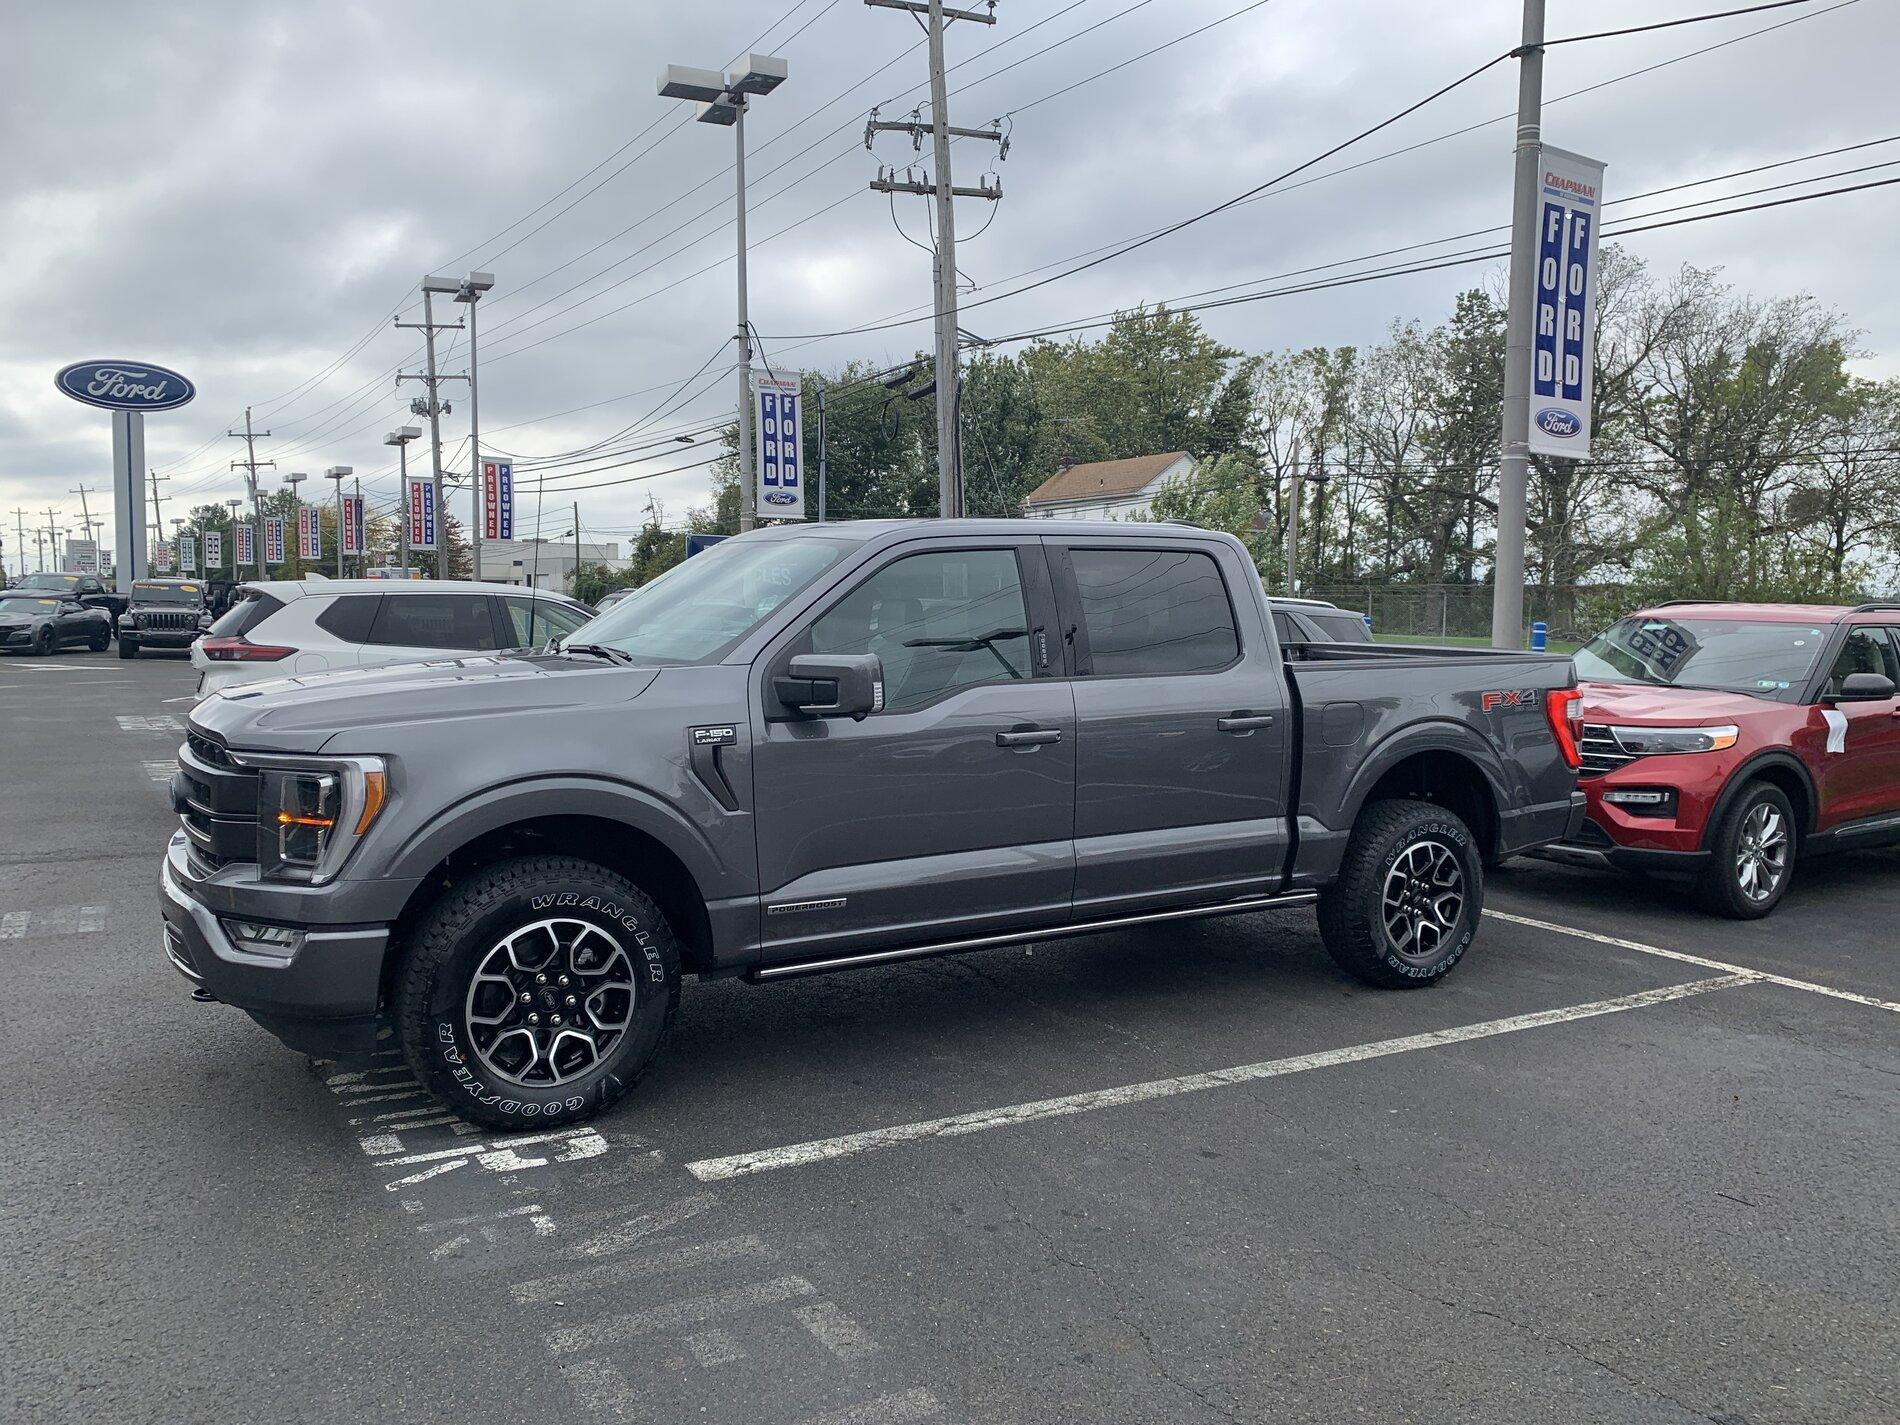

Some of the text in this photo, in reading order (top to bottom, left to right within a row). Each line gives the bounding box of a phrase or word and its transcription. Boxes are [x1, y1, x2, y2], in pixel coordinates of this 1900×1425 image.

[1538, 210, 1560, 382] FORD
[1565, 217, 1586, 386] FORD
[87, 368, 167, 400] Ford
[764, 395, 777, 479] FORD
[783, 397, 795, 480] FORD
[1544, 411, 1574, 433] Ford
[413, 484, 421, 542] PREOWNED
[425, 485, 433, 542] PREOWNED
[487, 466, 496, 536] PREOWNED
[501, 467, 510, 537] PREOWNED
[770, 493, 792, 504] Ford
[1481, 689, 1539, 714] FX4
[695, 728, 733, 738] F-150
[1385, 823, 1467, 866] WRANGLER
[771, 900, 844, 913] POWERBOOST
[531, 892, 664, 983] WRANGLER
[1388, 932, 1470, 978] GOODYEAR
[438, 1022, 585, 1117] GOODYEAR
